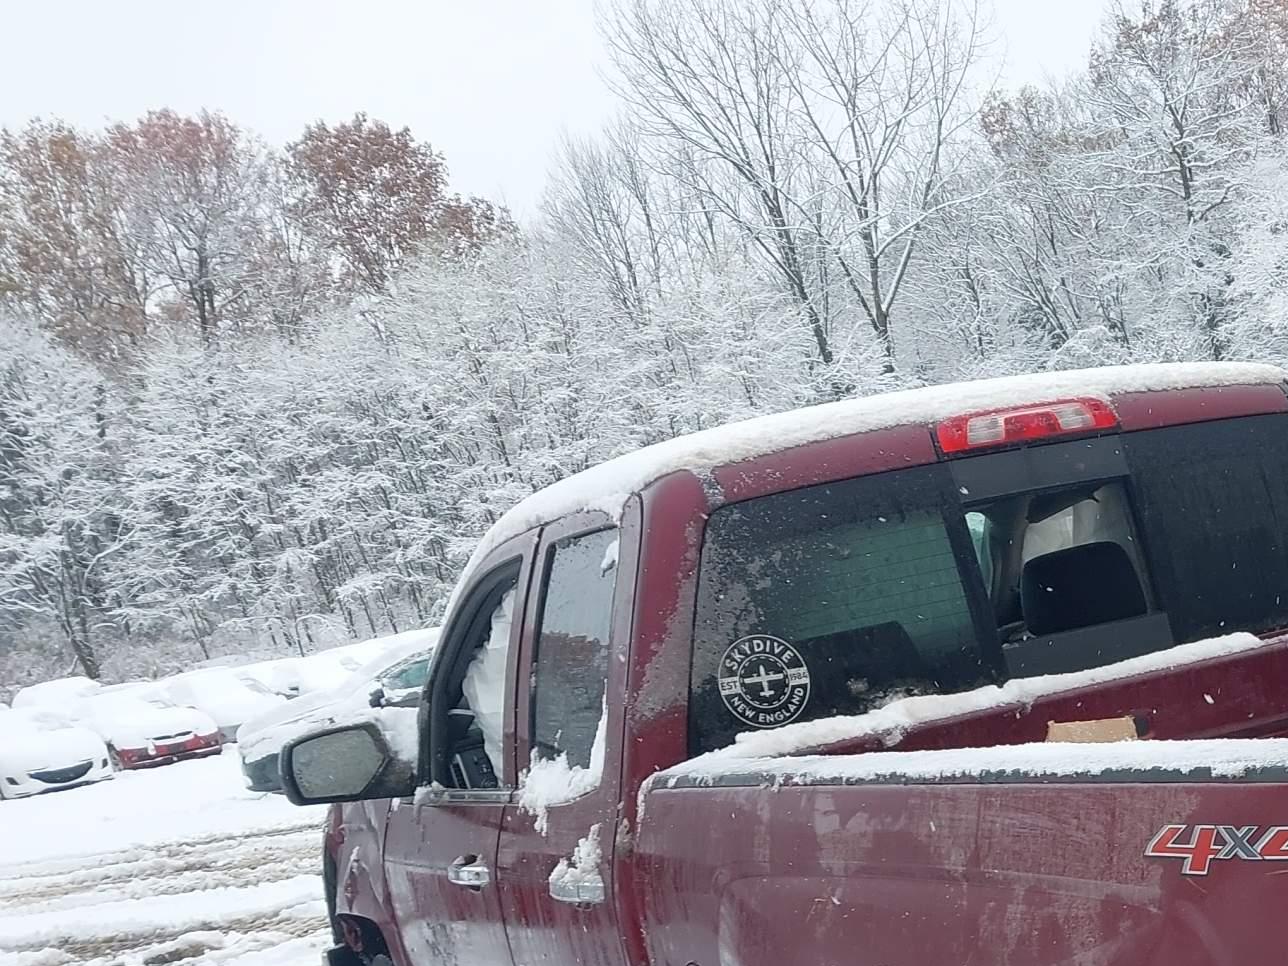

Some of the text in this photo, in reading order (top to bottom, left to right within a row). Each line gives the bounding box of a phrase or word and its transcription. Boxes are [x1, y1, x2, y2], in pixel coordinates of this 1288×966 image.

[725, 639, 795, 671] SKYDIVE
[730, 687, 804, 723] NEW ENGLAND
